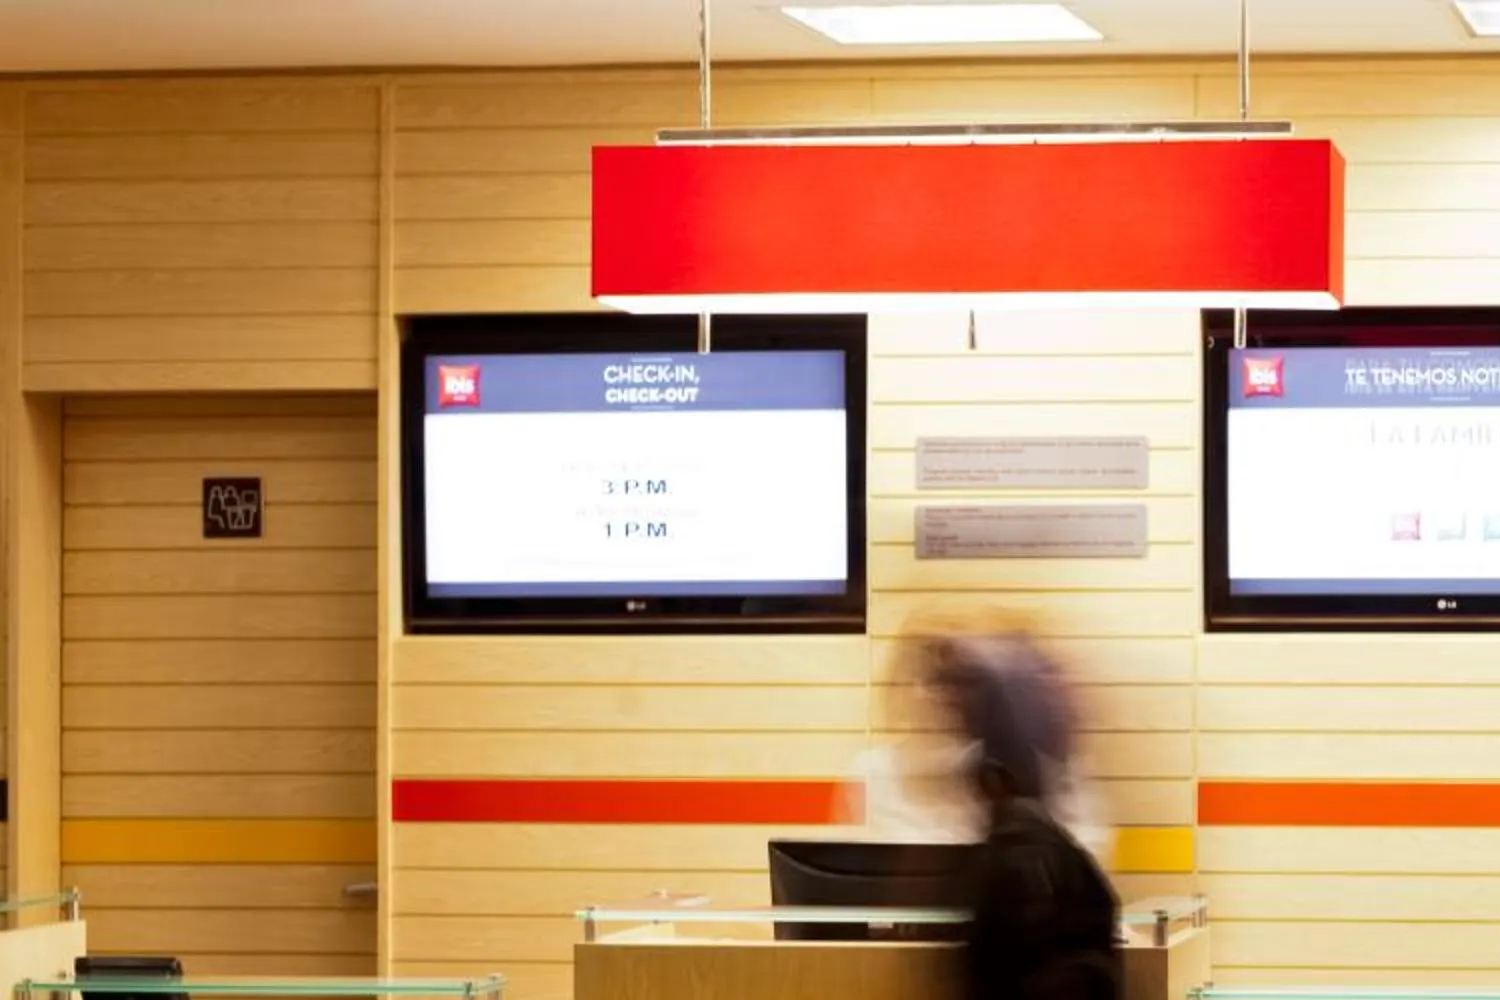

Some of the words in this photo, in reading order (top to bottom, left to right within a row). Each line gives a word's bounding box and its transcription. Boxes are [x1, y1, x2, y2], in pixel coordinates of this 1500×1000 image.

[604, 364, 700, 385] CHECK-IN,
[1250, 366, 1277, 385] ibis
[1345, 368, 1366, 385] TE
[1370, 368, 1456, 385] TENEMOS
[445, 376, 475, 394] ibis
[605, 387, 699, 403] CHECK-OUT
[601, 479, 614, 495] 3
[604, 522, 612, 537] 1
